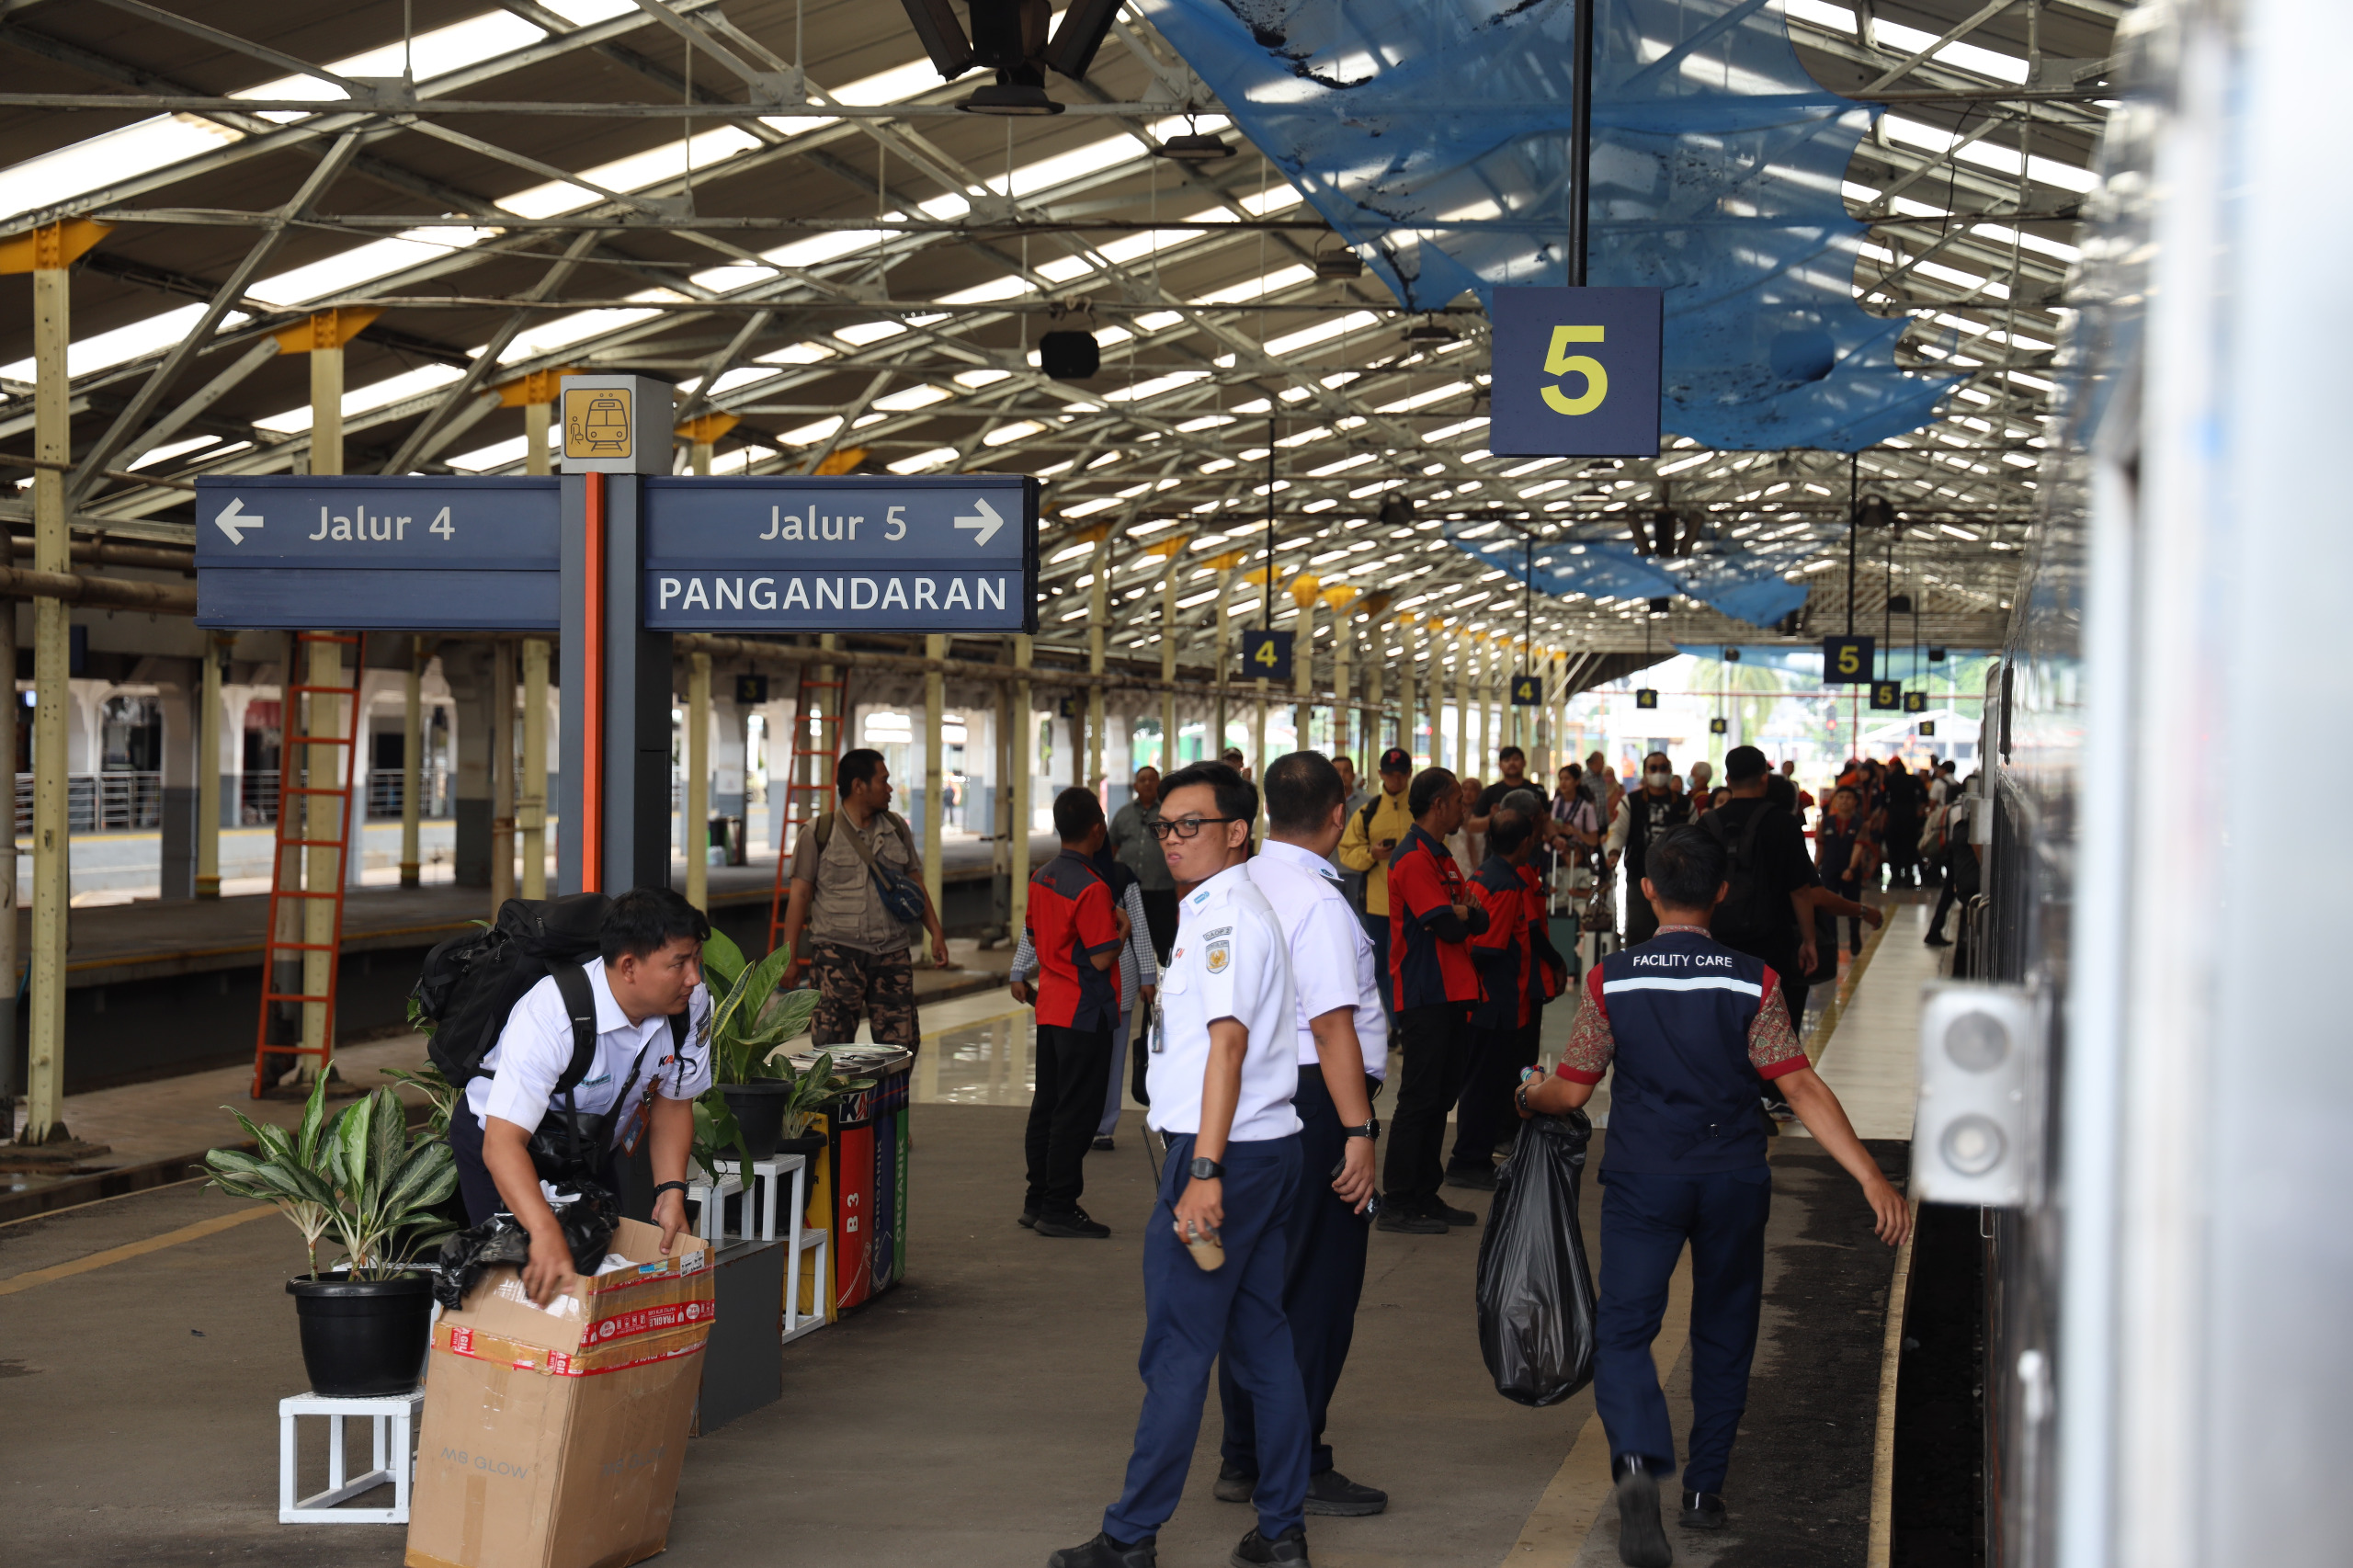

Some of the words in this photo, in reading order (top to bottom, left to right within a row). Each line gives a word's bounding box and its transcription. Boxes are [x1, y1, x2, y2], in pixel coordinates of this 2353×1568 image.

[1540, 325, 1608, 415] 5
[308, 505, 413, 541] Jalur
[428, 506, 456, 541] 4
[758, 504, 865, 541] Jalur
[883, 506, 907, 541] 5
[660, 577, 1006, 610] PANGANDARAN
[1255, 641, 1278, 668] 4
[1838, 646, 1859, 674] 5
[745, 681, 756, 698] 3
[1518, 682, 1533, 700] 4
[1641, 692, 1652, 705] 4
[1879, 686, 1893, 705] 5
[1713, 720, 1723, 732] 4
[1390, 751, 1401, 764] P
[1205, 928, 1224, 939] DAOP
[1632, 954, 1690, 967] FACILITY
[1695, 955, 1733, 968] CARE
[895, 1138, 904, 1243] ORGANIK
[847, 1192, 859, 1208] 3
[847, 1215, 858, 1233] B
[874, 1237, 880, 1262] AN
[649, 1314, 675, 1327] FRAGILE
[473, 1456, 529, 1479] GLOW
